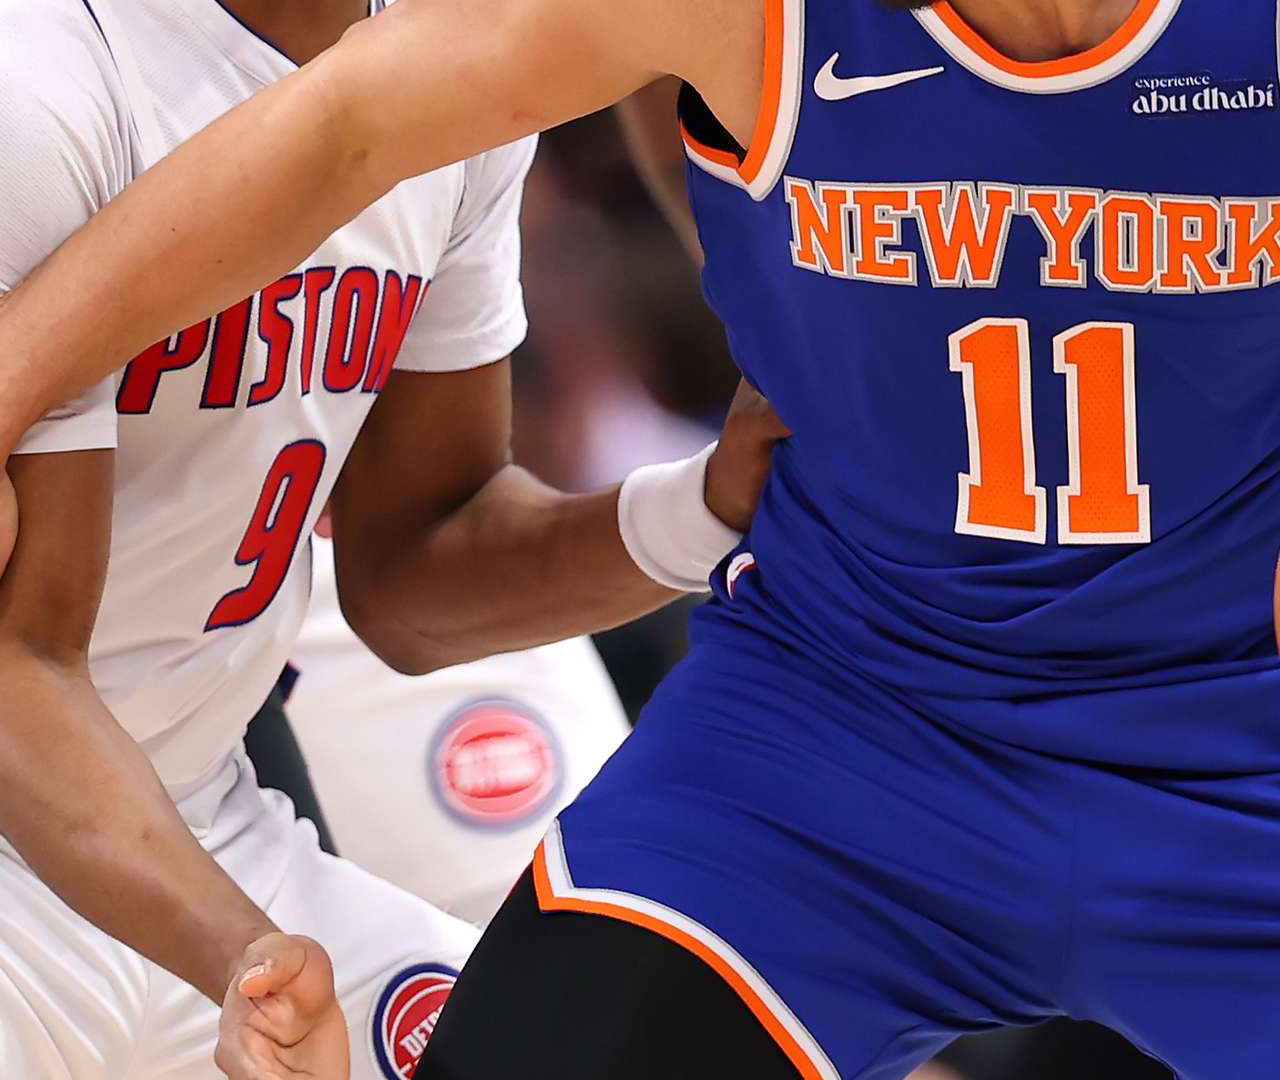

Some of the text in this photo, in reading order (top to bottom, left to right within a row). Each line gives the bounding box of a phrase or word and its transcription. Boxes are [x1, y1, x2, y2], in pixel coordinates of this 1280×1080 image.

[1131, 83, 1275, 115] abu dhabi
[1134, 74, 1211, 91] experience
[783, 175, 1019, 289] NEW
[116, 265, 431, 415] PISTON
[947, 316, 1152, 545] 11
[203, 438, 327, 634] 9
